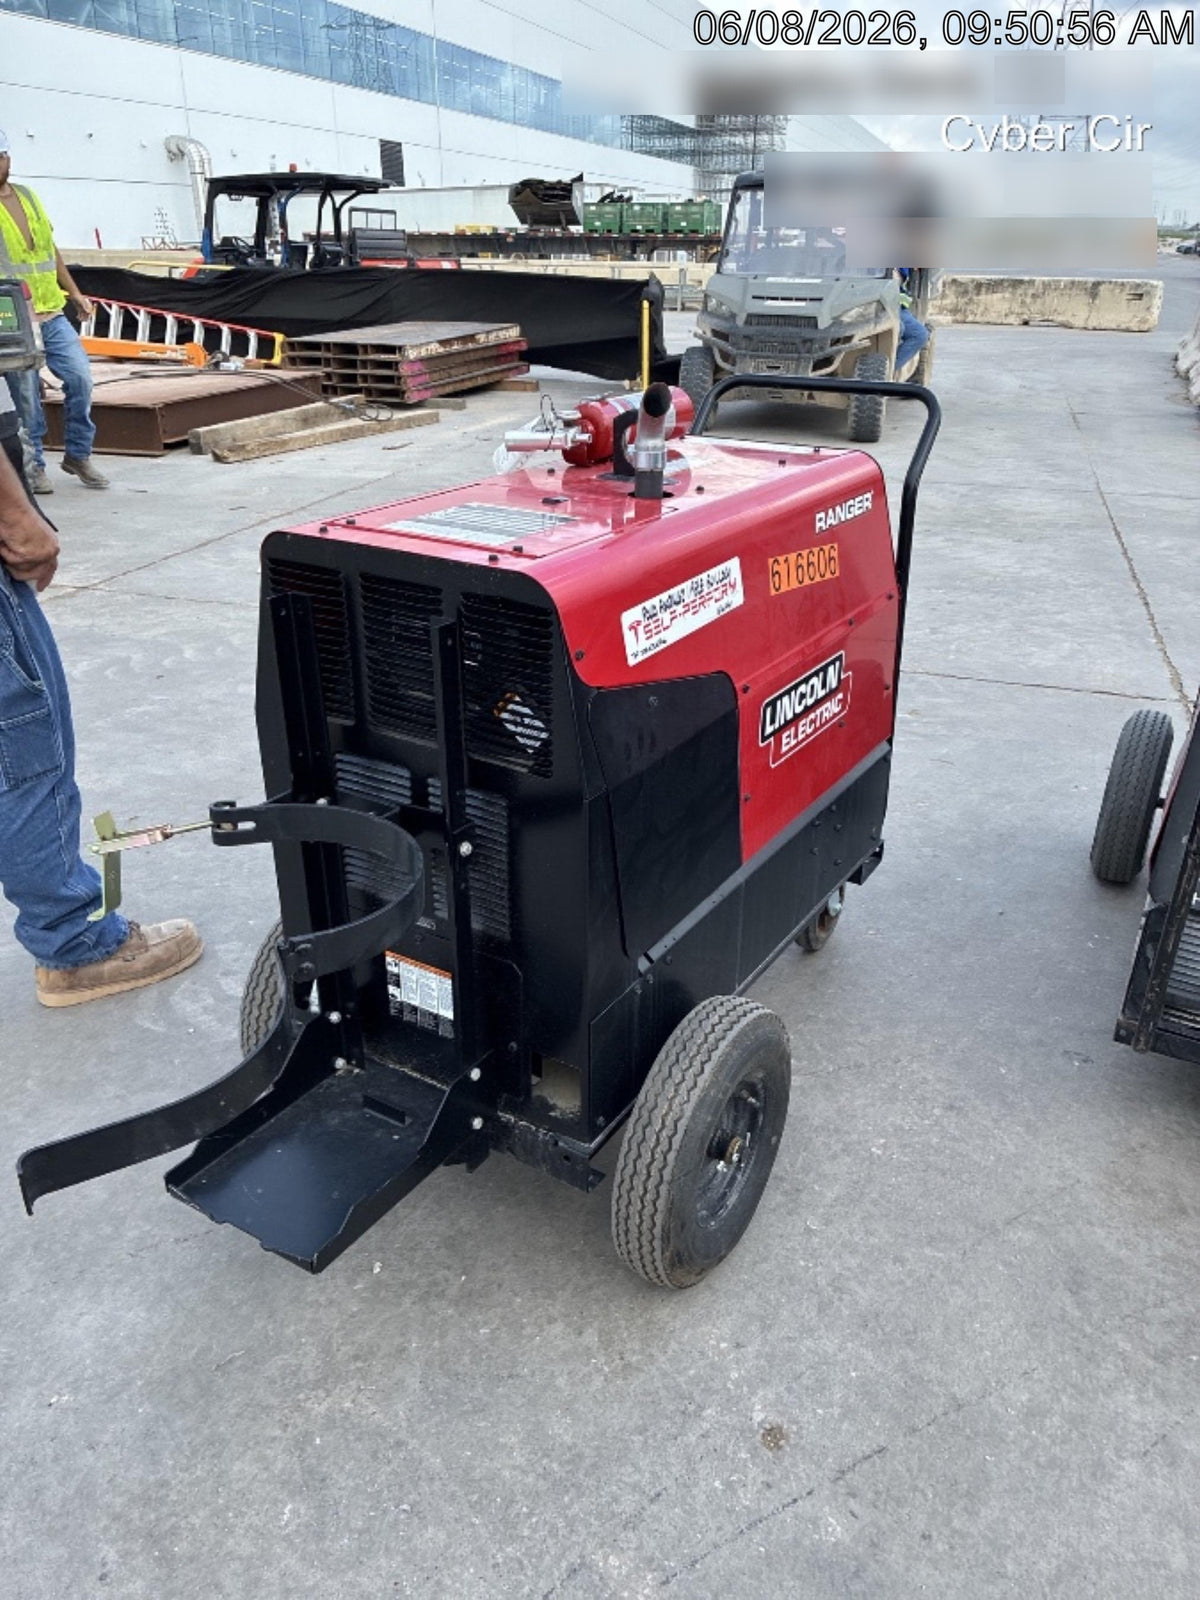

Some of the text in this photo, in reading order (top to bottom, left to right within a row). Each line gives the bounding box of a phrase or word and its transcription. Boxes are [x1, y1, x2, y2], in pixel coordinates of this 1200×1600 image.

[815, 493, 872, 533] RANGER
[771, 545, 837, 592] 616606
[764, 662, 840, 736] LINCOLN
[780, 692, 844, 753] ELECTRIC
